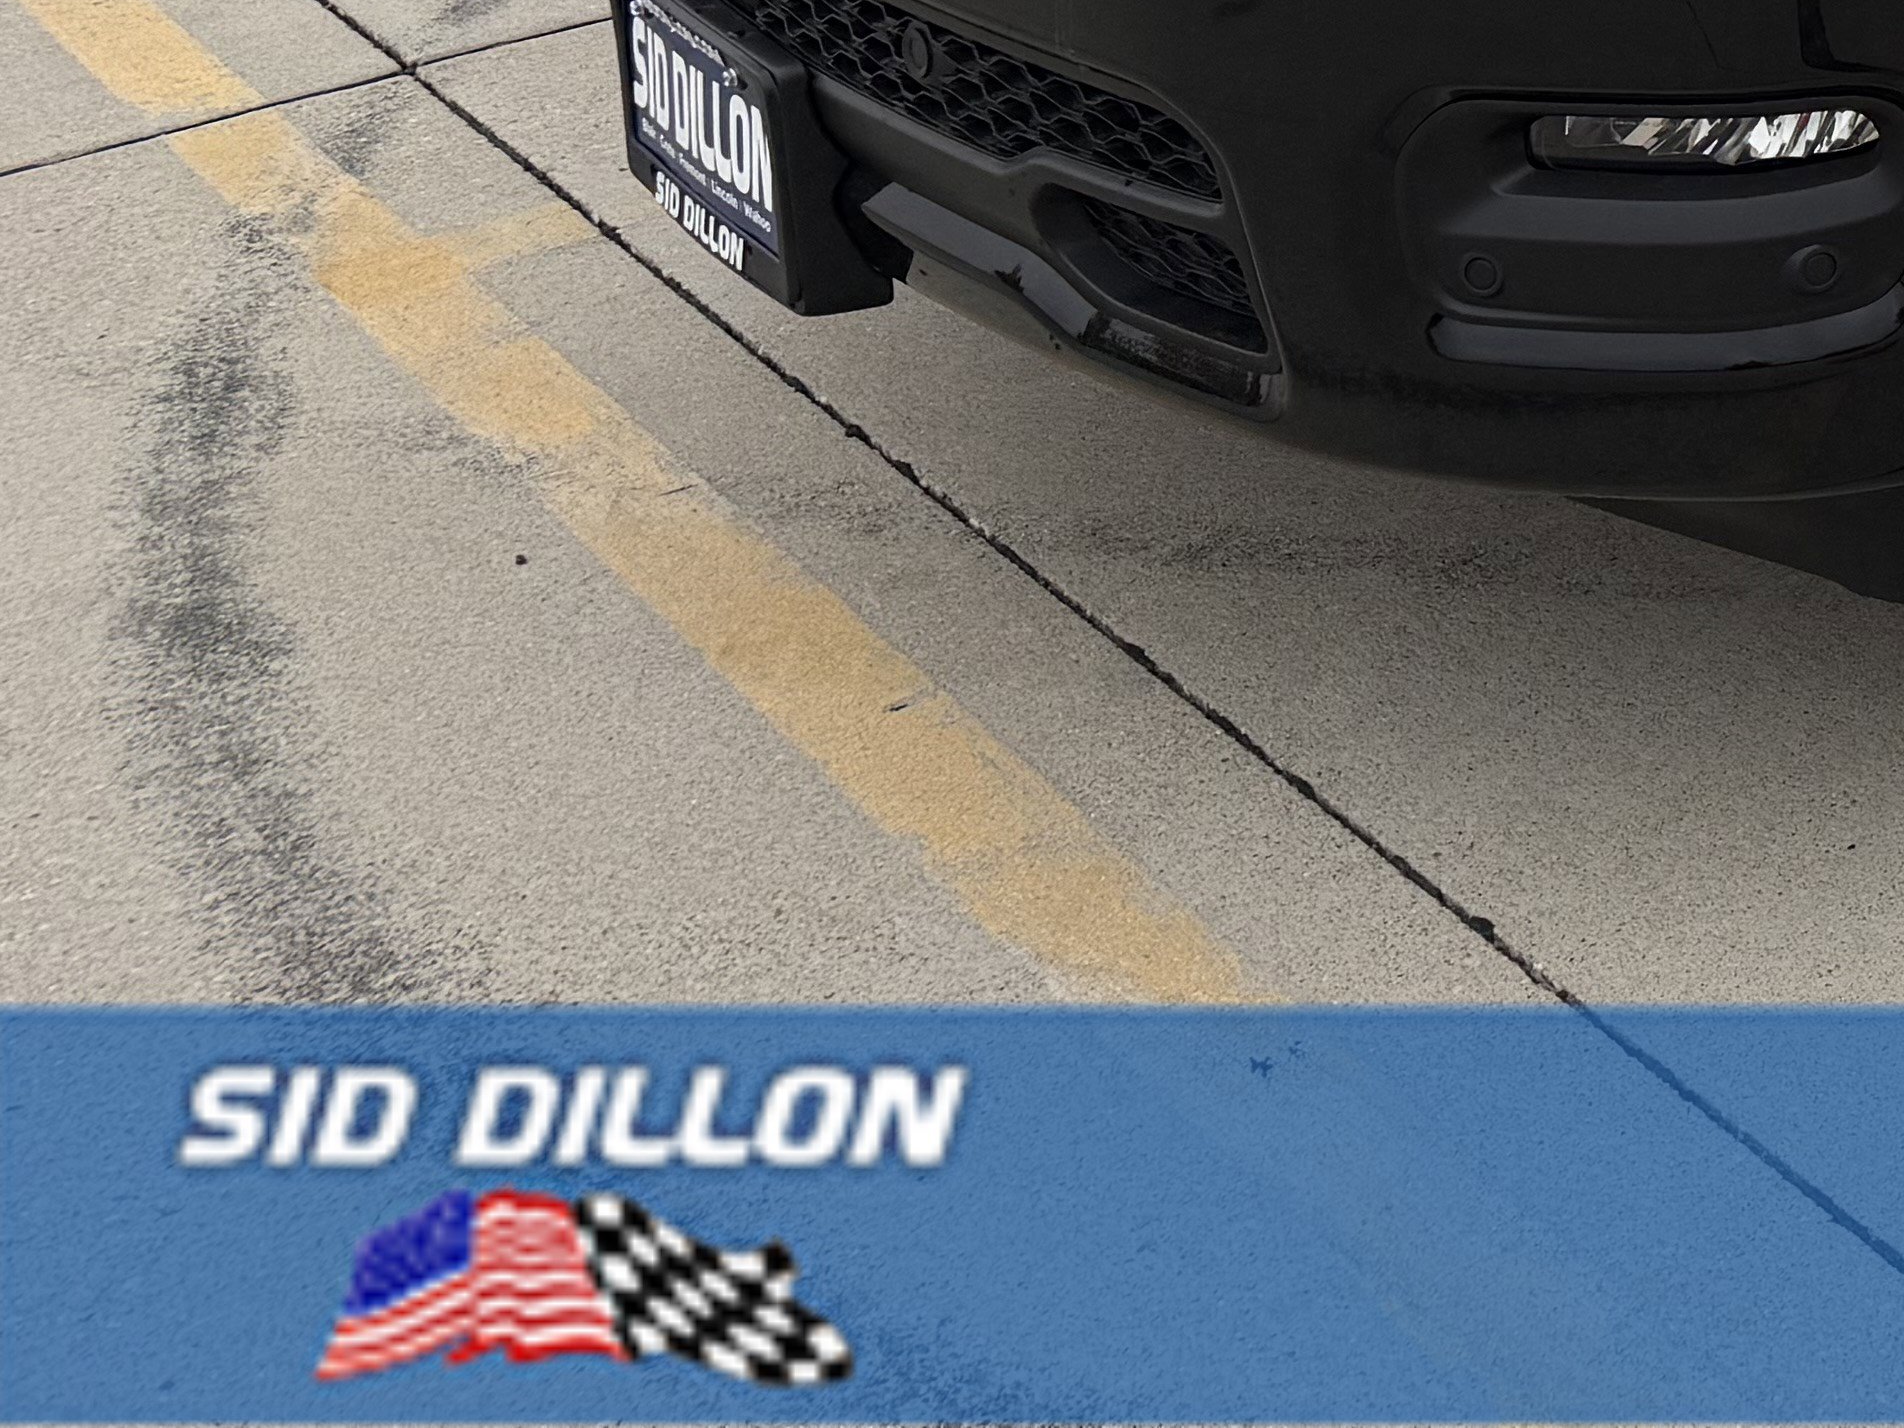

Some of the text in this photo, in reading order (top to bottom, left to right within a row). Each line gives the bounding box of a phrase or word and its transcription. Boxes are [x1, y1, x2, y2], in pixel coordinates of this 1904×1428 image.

[632, 16, 670, 131] SID
[671, 49, 773, 213] DILLON
[654, 170, 745, 271] SID DILLON
